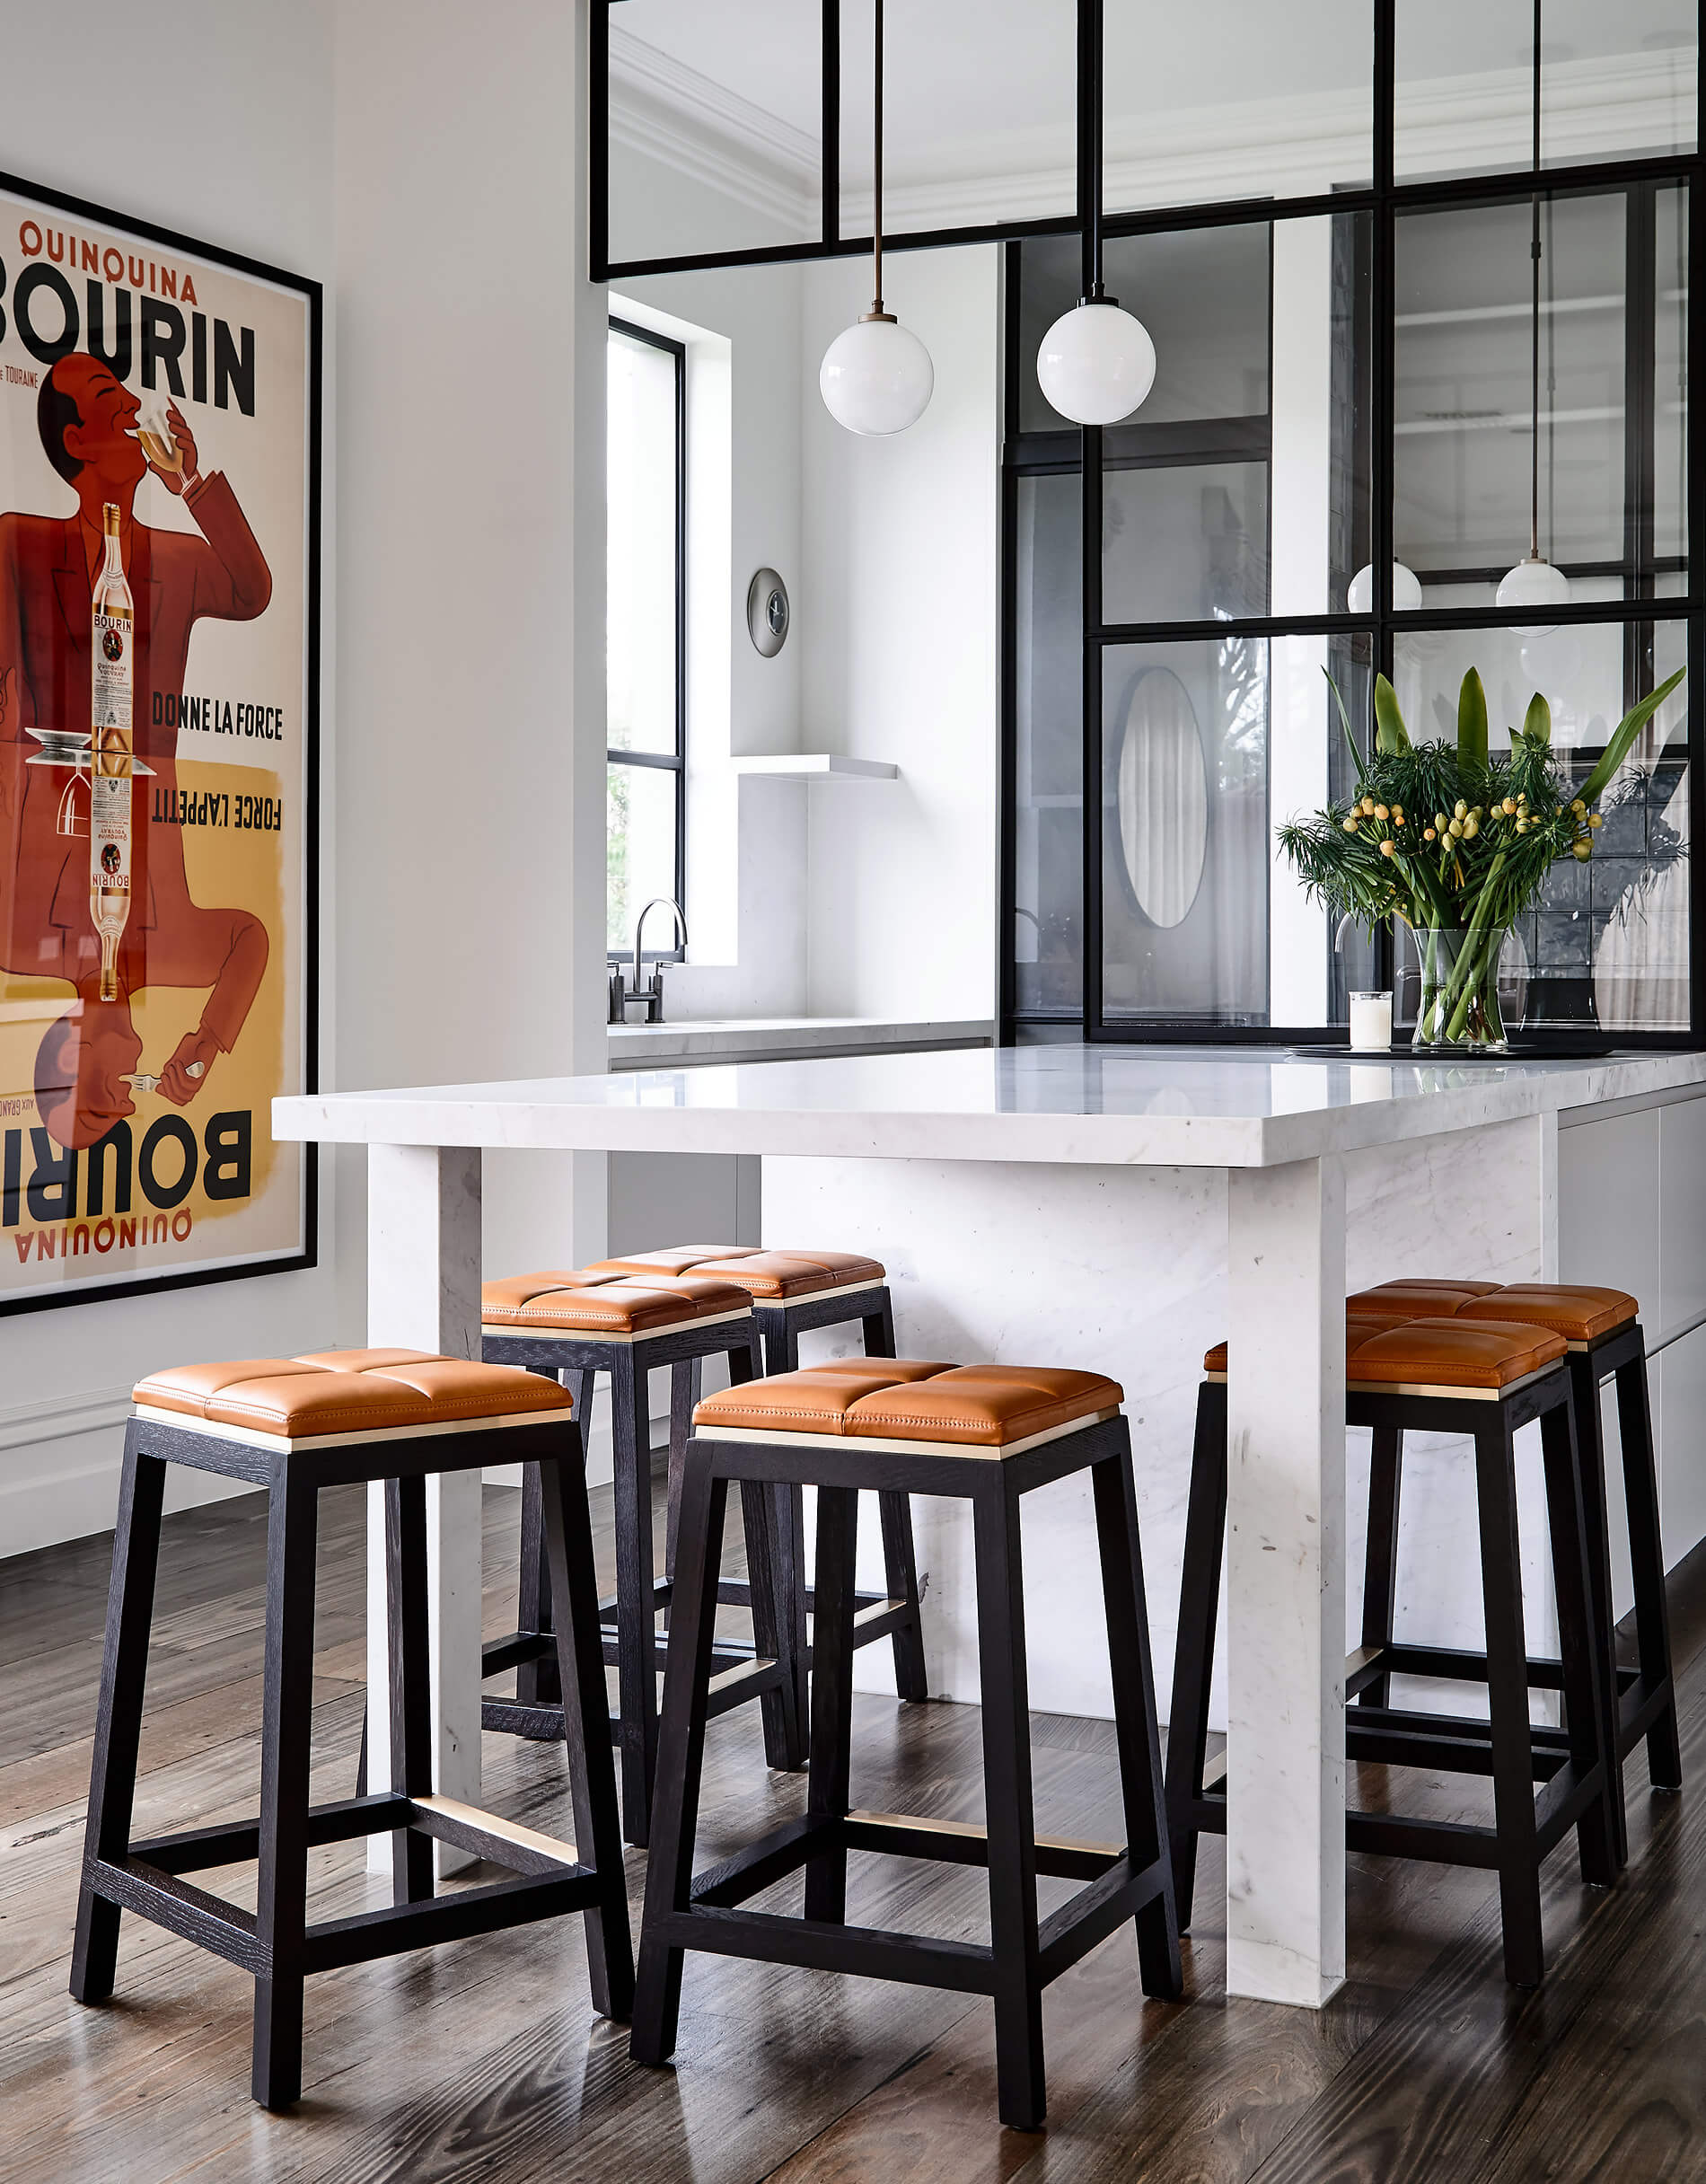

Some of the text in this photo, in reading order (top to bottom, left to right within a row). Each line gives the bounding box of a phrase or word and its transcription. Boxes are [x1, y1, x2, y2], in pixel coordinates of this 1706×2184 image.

[19, 220, 198, 306] QUINQUINA
[0, 254, 256, 418] OURIN
[4, 365, 39, 389] TOURAINE
[94, 614, 132, 631] BOURIN
[152, 691, 211, 732] DONNE
[215, 700, 233, 735] LA
[236, 702, 283, 741] FORCE
[151, 788, 230, 827] L'APPÉTIT
[233, 795, 282, 832] FORCE
[92, 874, 129, 887] BOURIN
[22, 1099, 35, 1111] AUX
[13, 1206, 193, 1264] QUINQUINA
